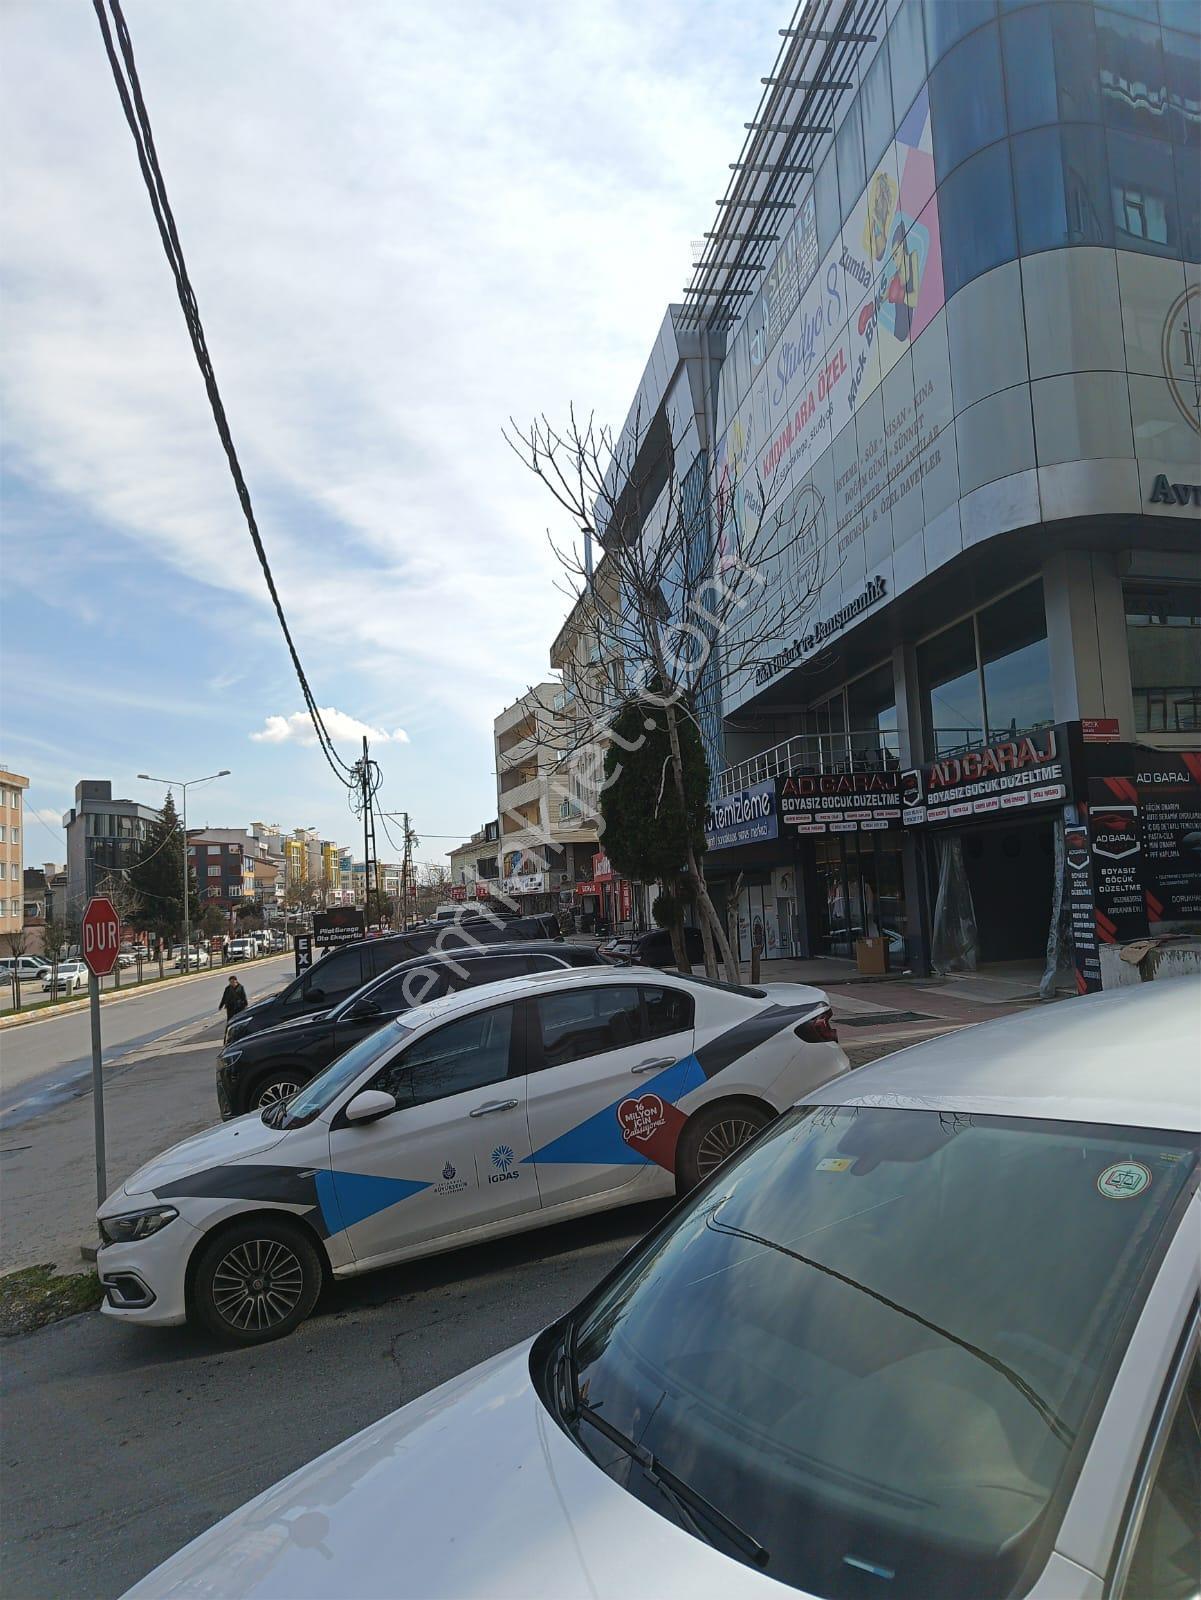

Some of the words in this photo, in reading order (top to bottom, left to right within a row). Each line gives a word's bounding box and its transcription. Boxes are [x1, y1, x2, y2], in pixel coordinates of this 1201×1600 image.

[818, 347, 847, 402] ÖZEL
[928, 758, 961, 790] AD
[962, 730, 1057, 781] GARAJ
[1136, 773, 1152, 783] AD
[1153, 772, 1190, 783] GARAJ
[927, 787, 965, 805] BOYASIZ
[714, 792, 771, 830] temizleme
[781, 797, 821, 811] BOYASIZ
[1108, 833, 1136, 842] GARAJ
[1101, 867, 1136, 876] BOYASIZ
[1099, 883, 1142, 893] DÜZELTME
[85, 921, 117, 953] DUR
[634, 1104, 645, 1112] 16
